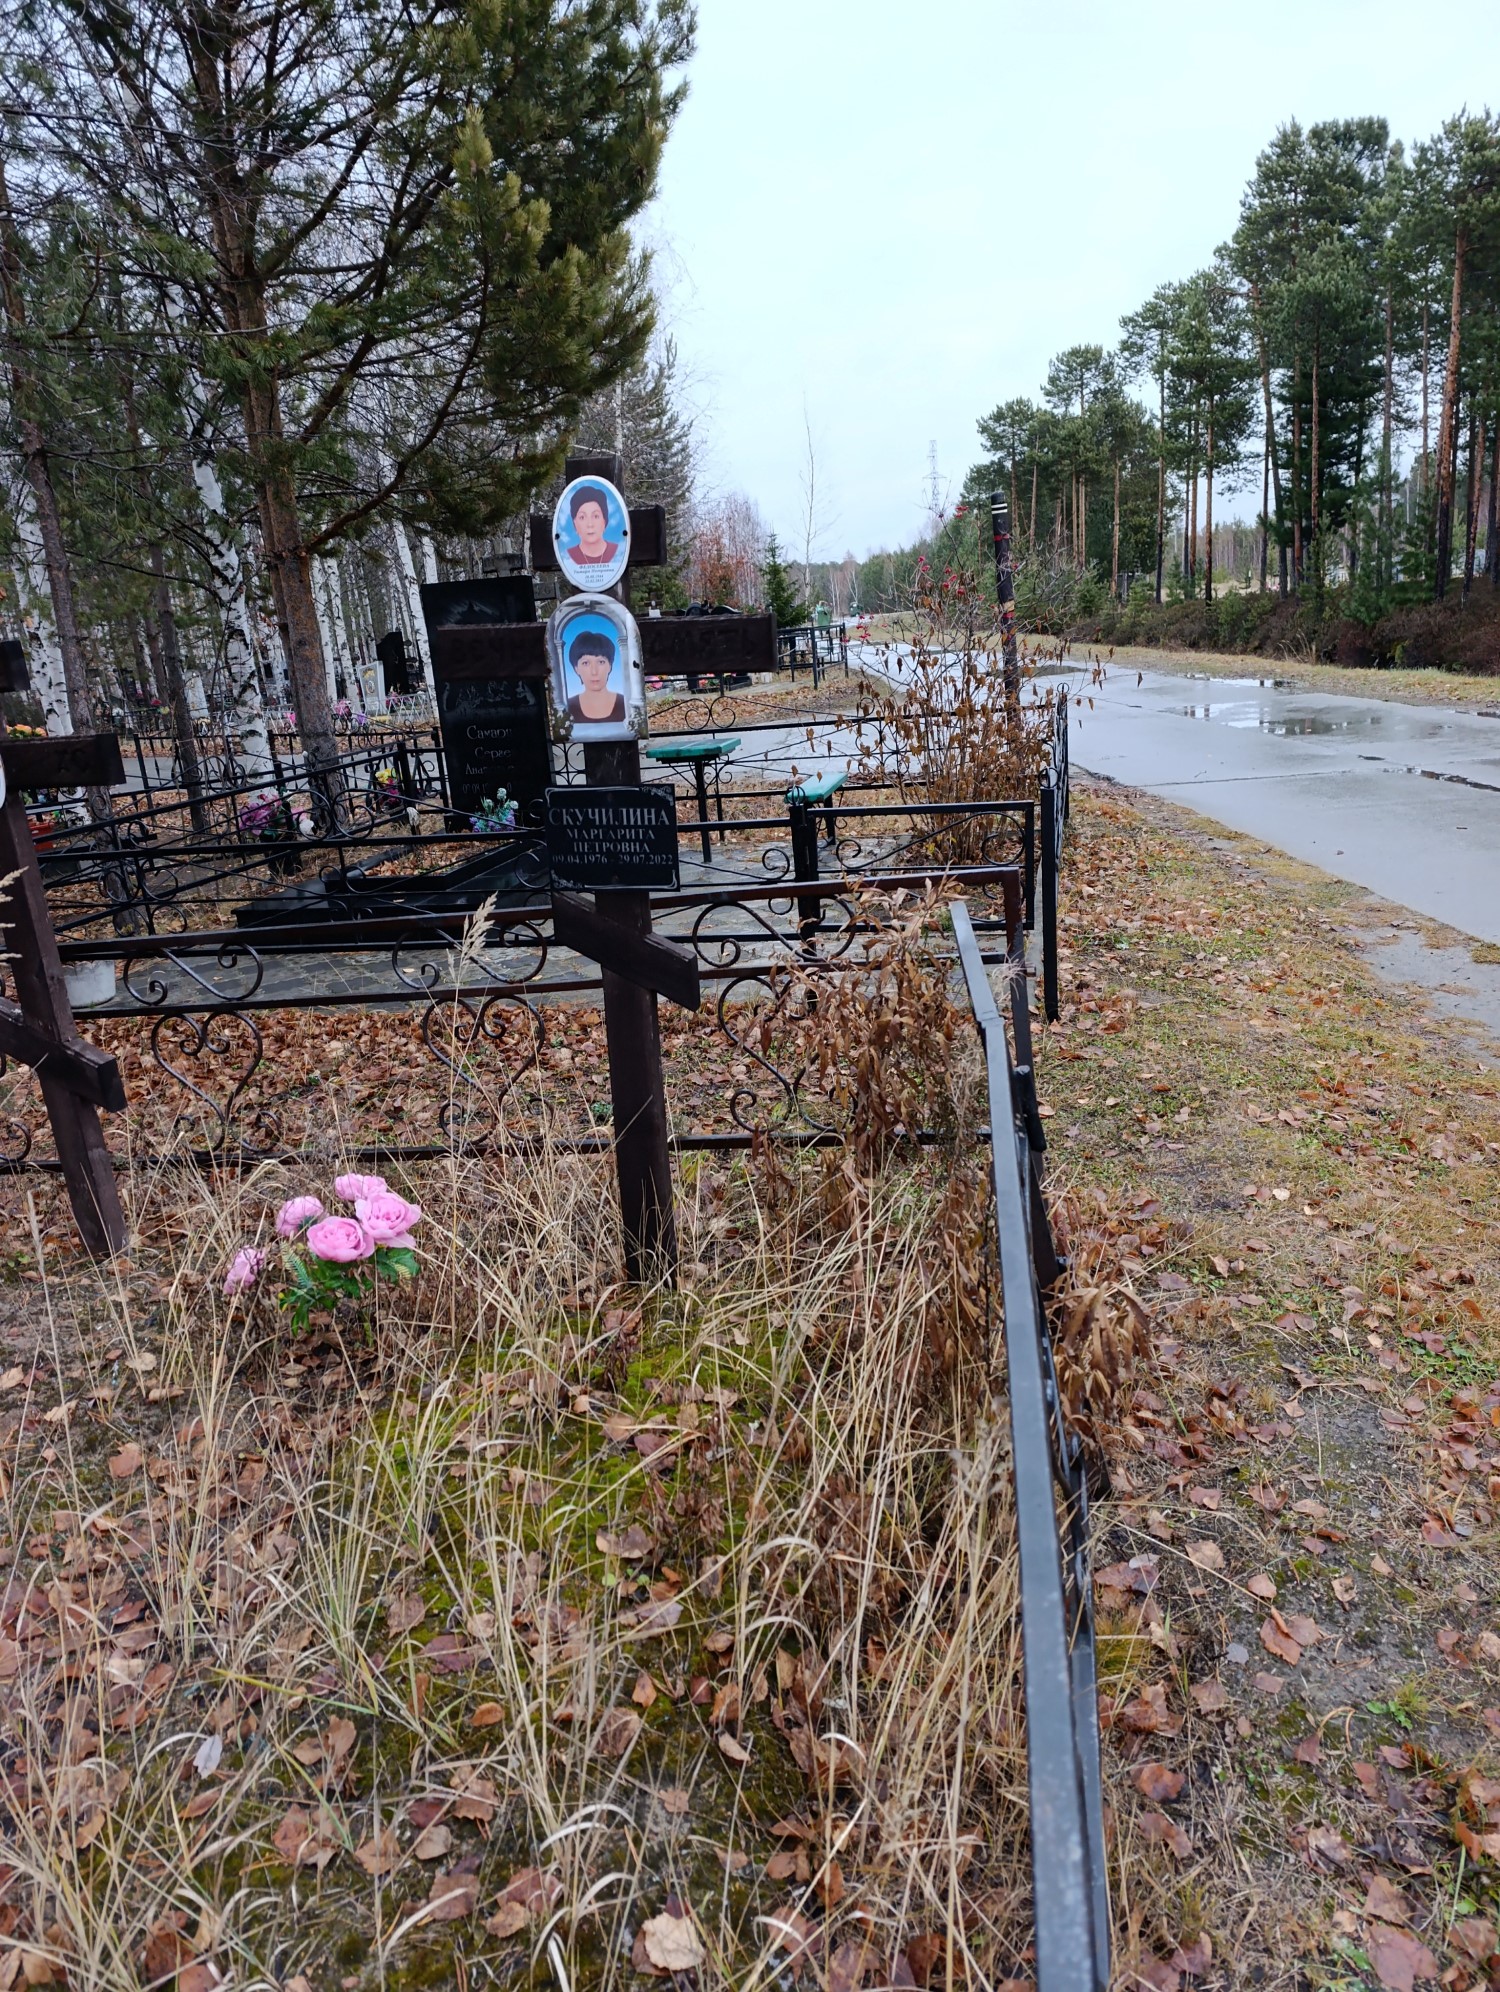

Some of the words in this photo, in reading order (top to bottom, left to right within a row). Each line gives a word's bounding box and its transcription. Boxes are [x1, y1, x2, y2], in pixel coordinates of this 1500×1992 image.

[548, 807, 670, 826] СКУЧИЛИНА
[566, 828, 656, 840] МАРГАРИТА
[573, 841, 651, 853] ПЕТРОВНА
[552, 854, 608, 865] 09.04.1976
[618, 853, 674, 865] 29.07.2022
